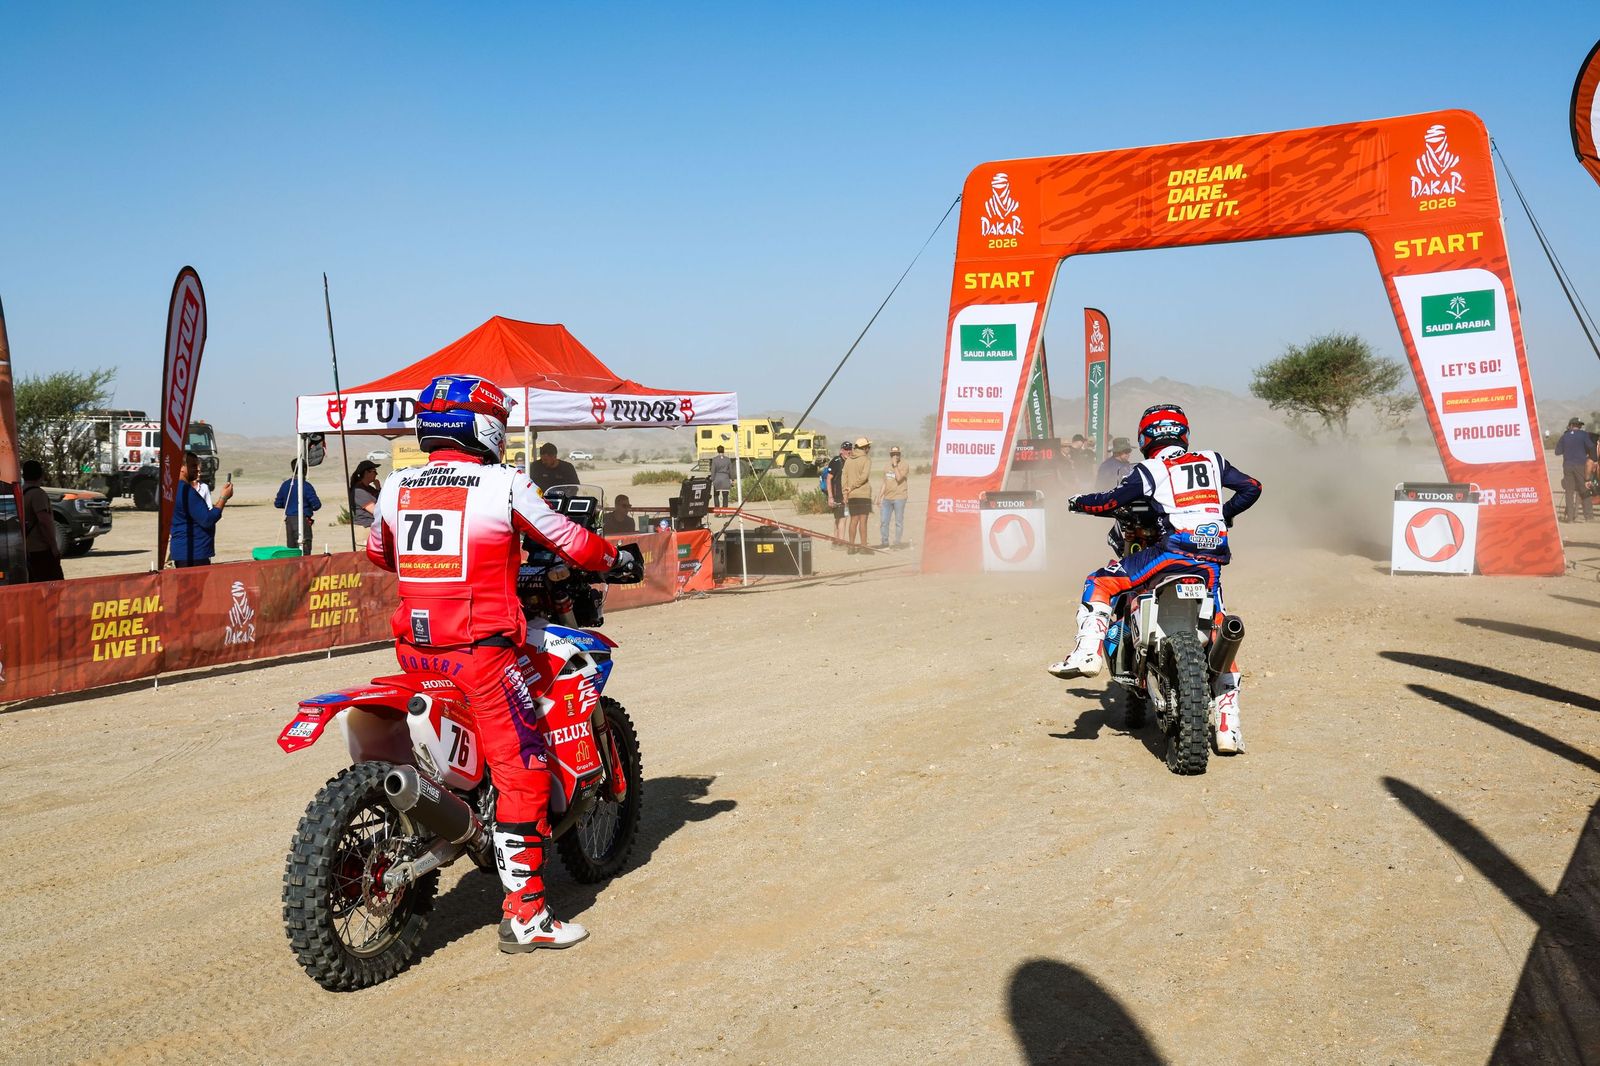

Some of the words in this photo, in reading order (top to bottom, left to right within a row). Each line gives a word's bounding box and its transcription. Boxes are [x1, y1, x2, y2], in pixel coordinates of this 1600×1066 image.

[1167, 164, 1248, 187] DREAM.
[1410, 171, 1466, 198] DAKAR
[1167, 184, 1228, 204] DARE.
[1419, 197, 1457, 211] 2026
[1167, 203, 1213, 222] LIVE
[1216, 200, 1240, 217] IT.
[981, 215, 1024, 236] DAKAR
[988, 238, 1018, 249] 2026
[1394, 231, 1484, 259] START
[964, 270, 1035, 290] START
[1425, 323, 1454, 333] SAUDI
[1455, 319, 1491, 330] ARABIA
[170, 298, 198, 431] MOTUL
[963, 350, 985, 358] SAUDI
[1441, 361, 1477, 378] LET'S
[1480, 358, 1502, 374] GO!
[480, 387, 502, 405] VELUX
[957, 386, 984, 399] LET'S
[986, 386, 1003, 398] GO!
[354, 397, 416, 424] TUD
[611, 399, 681, 422] TUDOR
[1032, 389, 1043, 431] ARABIA
[1453, 423, 1521, 441] PROLOGUE
[946, 443, 996, 455] PROLOGUE
[420, 467, 457, 477] ROBERT
[1180, 463, 1210, 490] 78
[996, 500, 1025, 508] TUDOR
[1417, 492, 1454, 501] TUDOR
[1500, 492, 1538, 500] RALLY-RAID
[404, 513, 443, 551] 76
[309, 572, 362, 593] DREAM.
[91, 594, 164, 620] DREAM.
[309, 591, 351, 611] DARE.
[91, 617, 149, 641] DARE.
[310, 609, 341, 629] LIVE
[343, 608, 359, 623] IT.
[224, 623, 256, 646] DAKAR
[93, 639, 137, 662] LIVE
[141, 635, 164, 655] IT.
[421, 680, 456, 689] HOND
[543, 721, 590, 747] VELUX
[447, 724, 470, 768] 76
